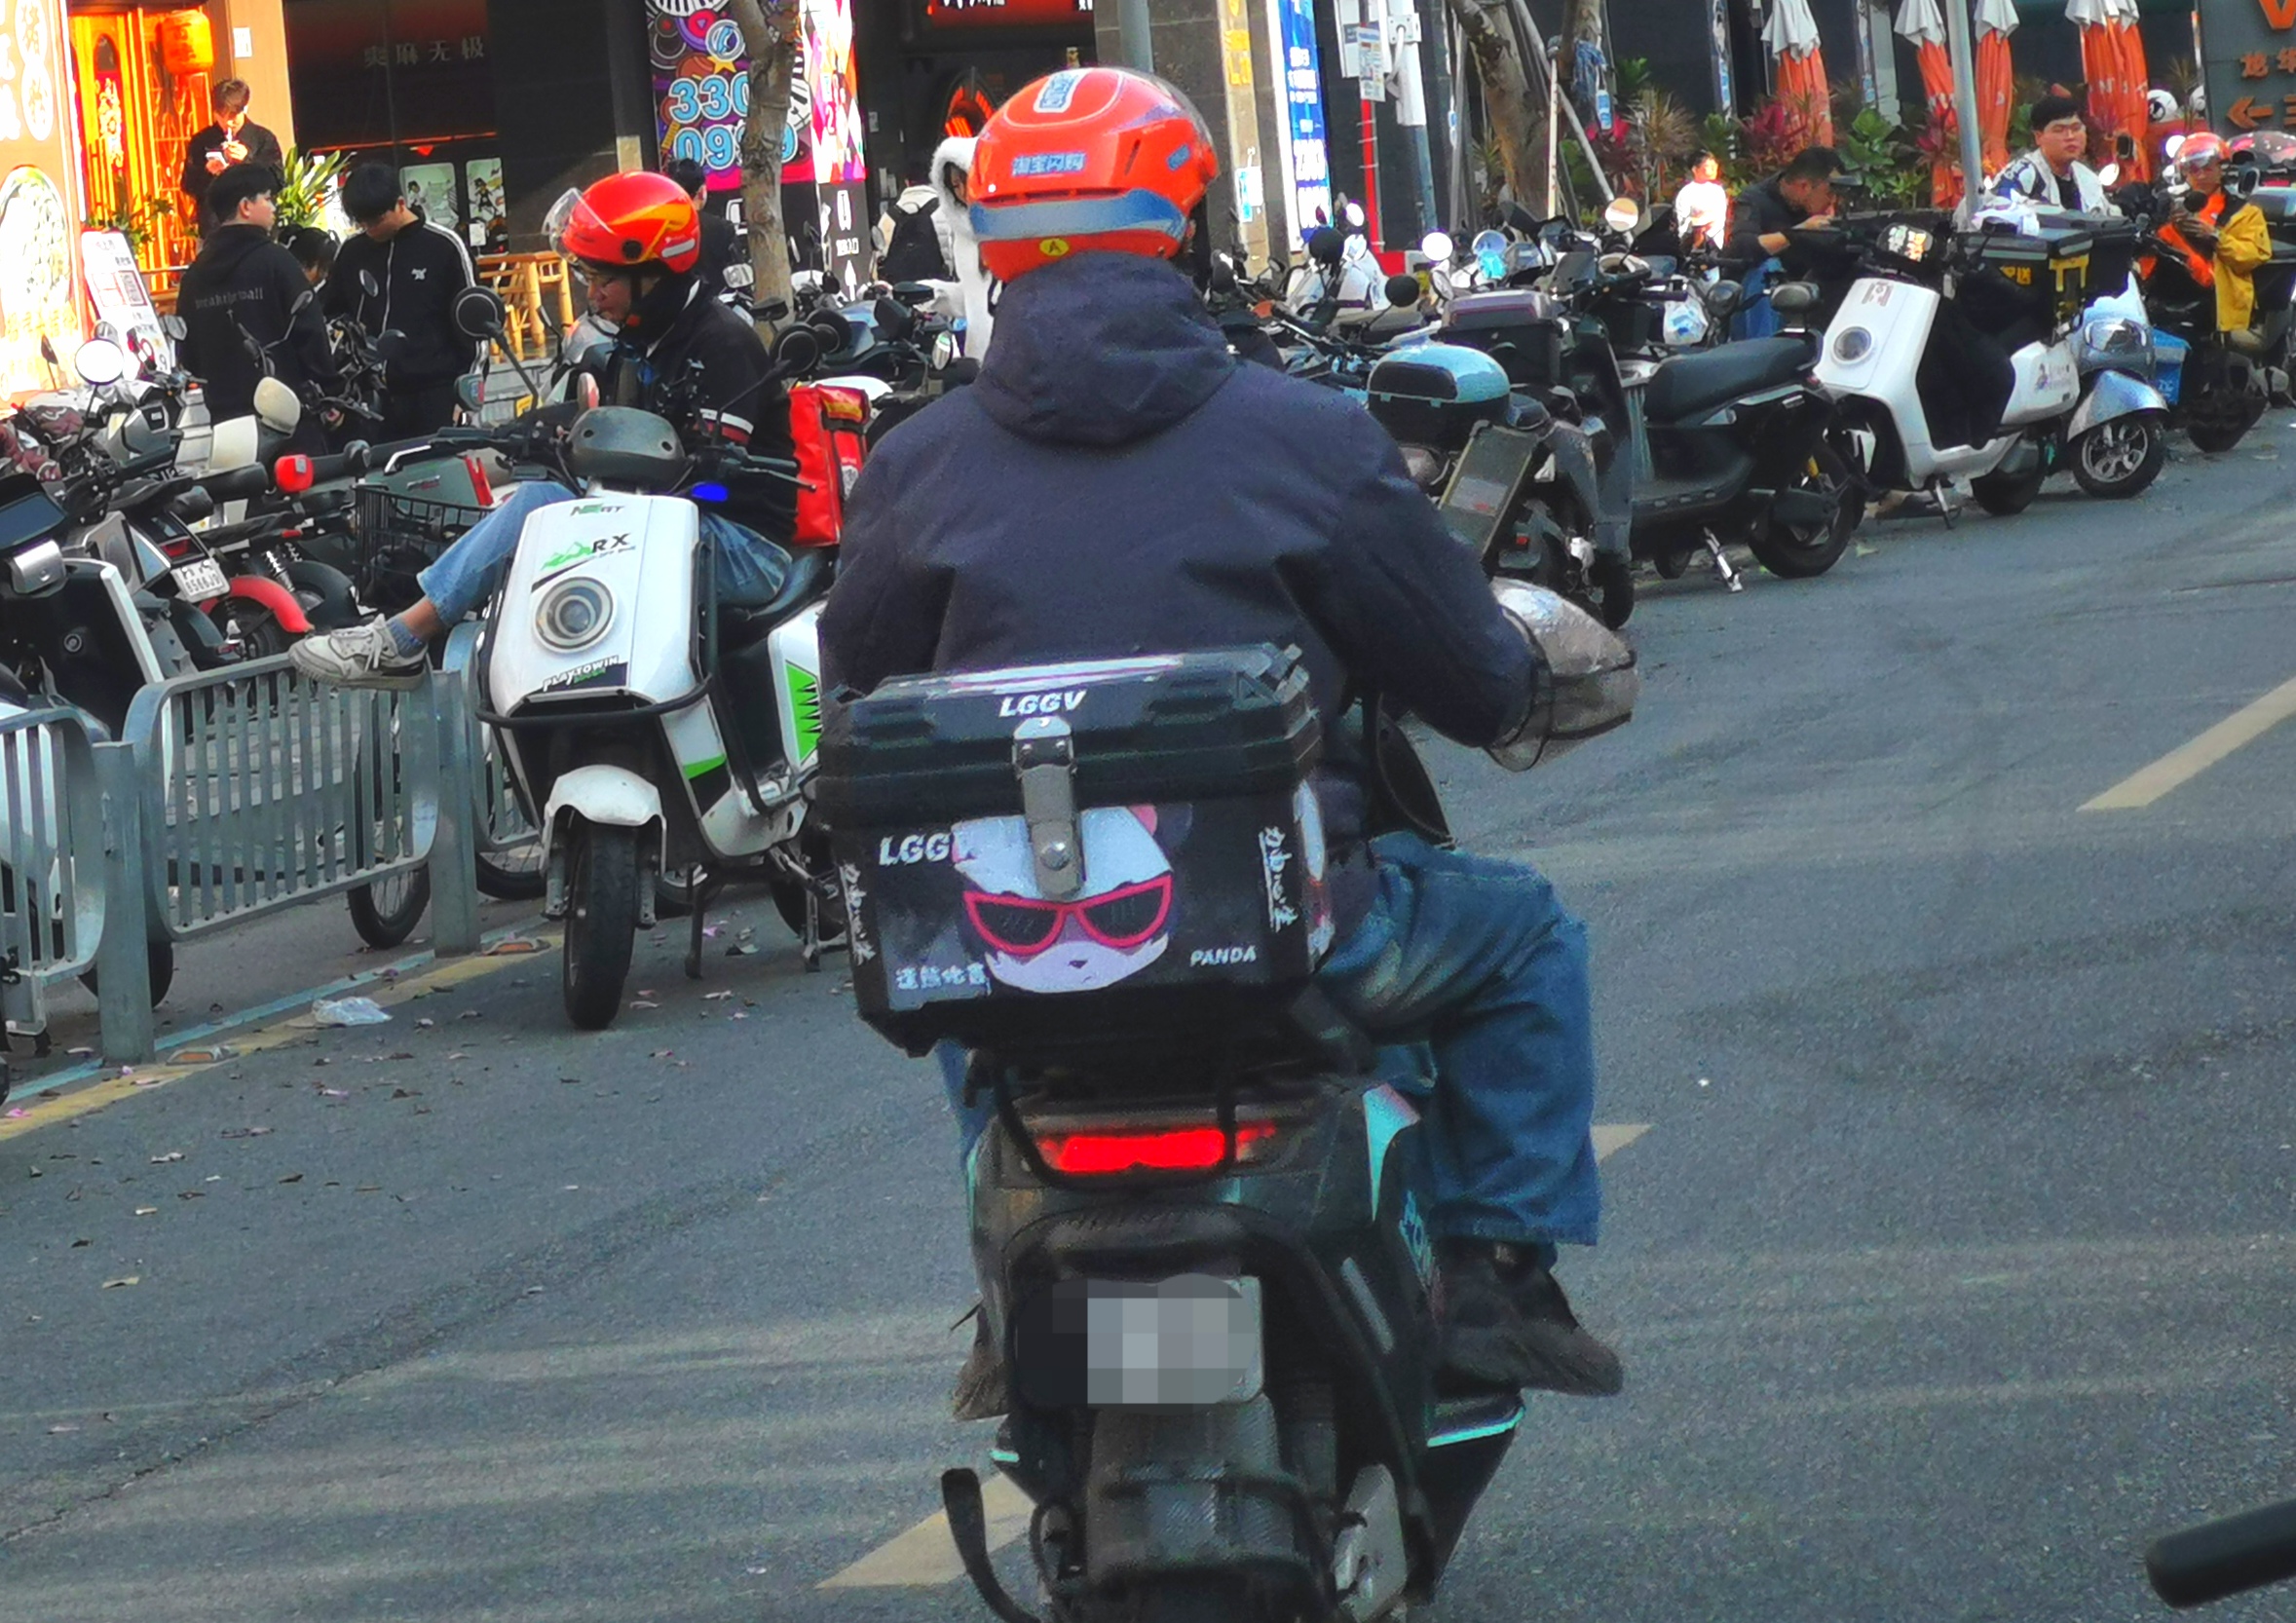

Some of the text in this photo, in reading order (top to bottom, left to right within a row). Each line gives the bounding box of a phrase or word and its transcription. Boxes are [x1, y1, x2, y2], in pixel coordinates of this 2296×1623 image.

[543, 656, 619, 693] PLAYTOWIN
[998, 689, 1088, 718] LGGV
[1189, 944, 1258, 967] PANDA
